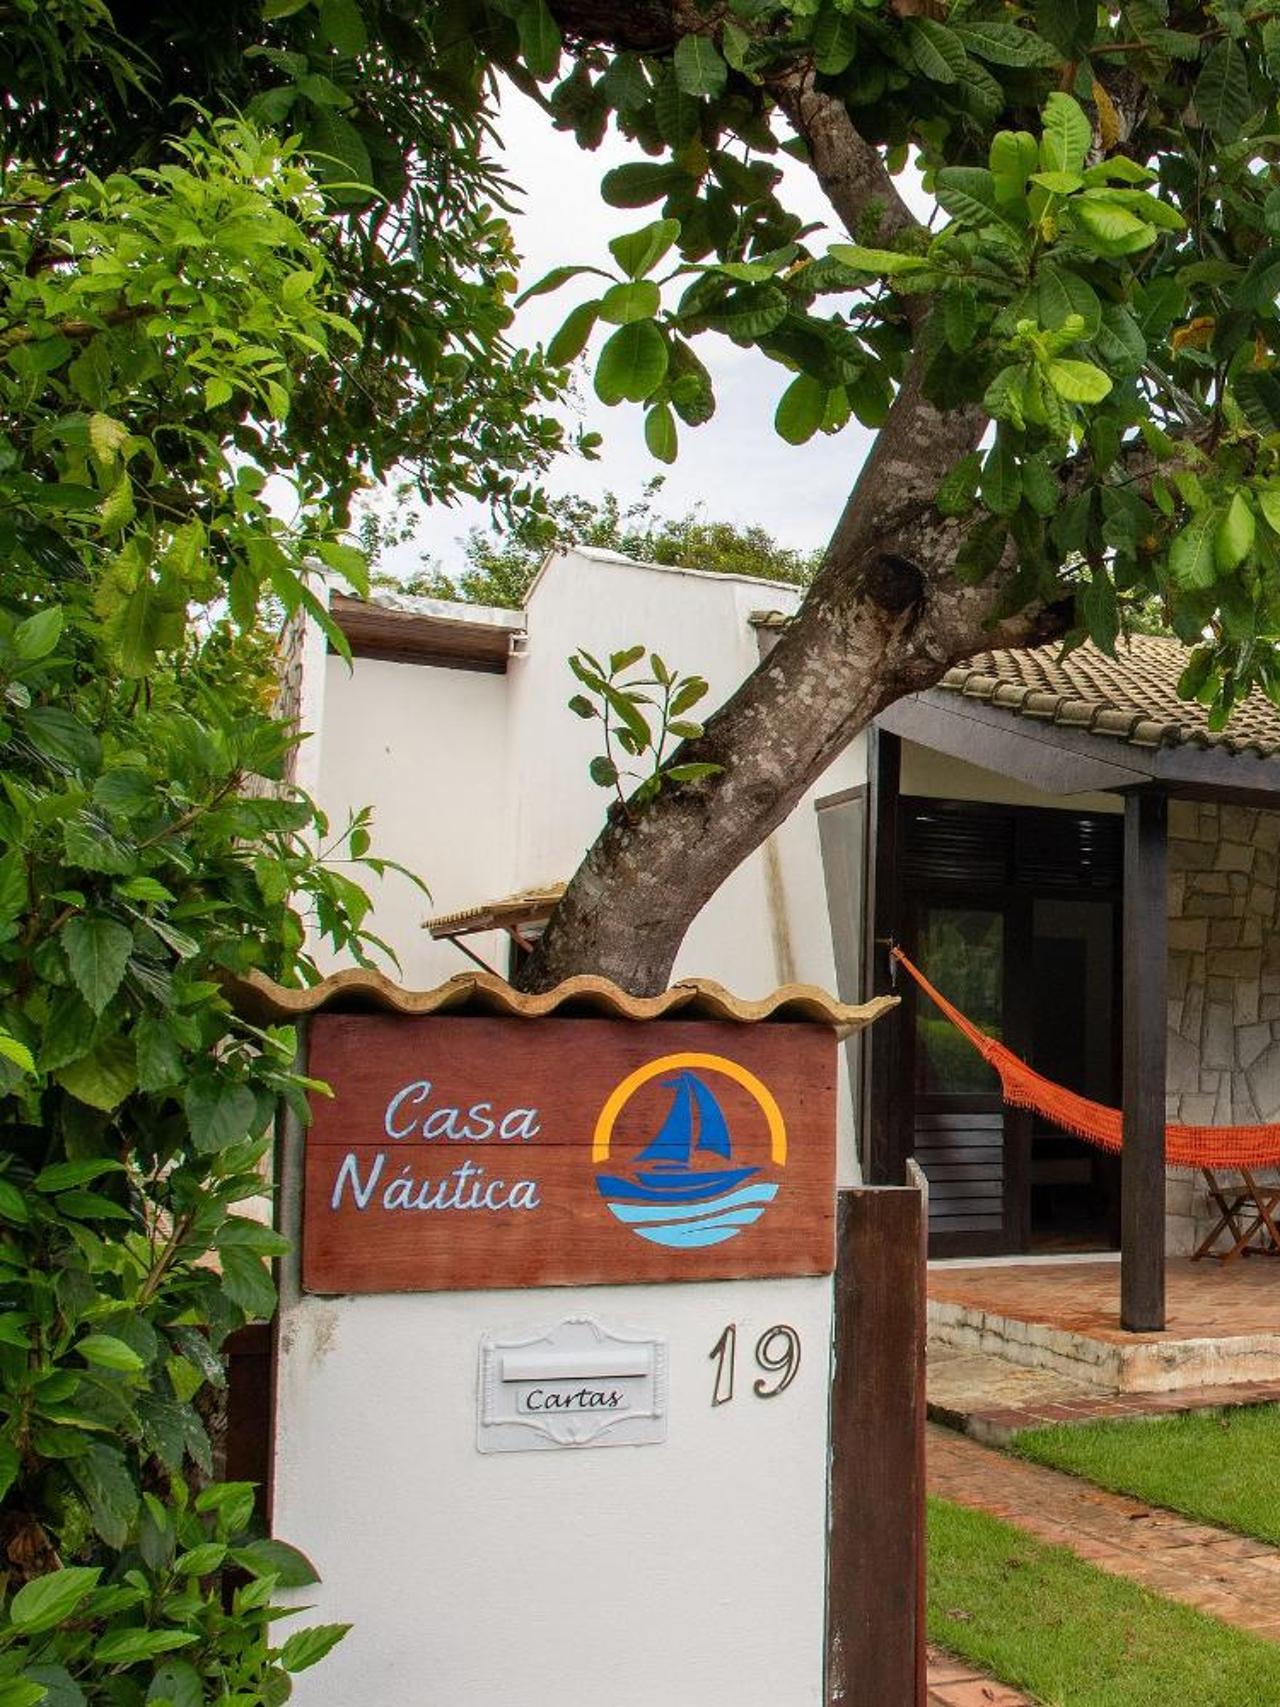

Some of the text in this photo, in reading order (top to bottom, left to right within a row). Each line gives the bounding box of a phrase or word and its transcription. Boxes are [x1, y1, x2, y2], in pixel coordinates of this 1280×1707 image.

[384, 1080, 541, 1141] Casa
[330, 1153, 541, 1211] Náutica
[709, 1322, 802, 1407] 19
[525, 1386, 623, 1411] Cartas
